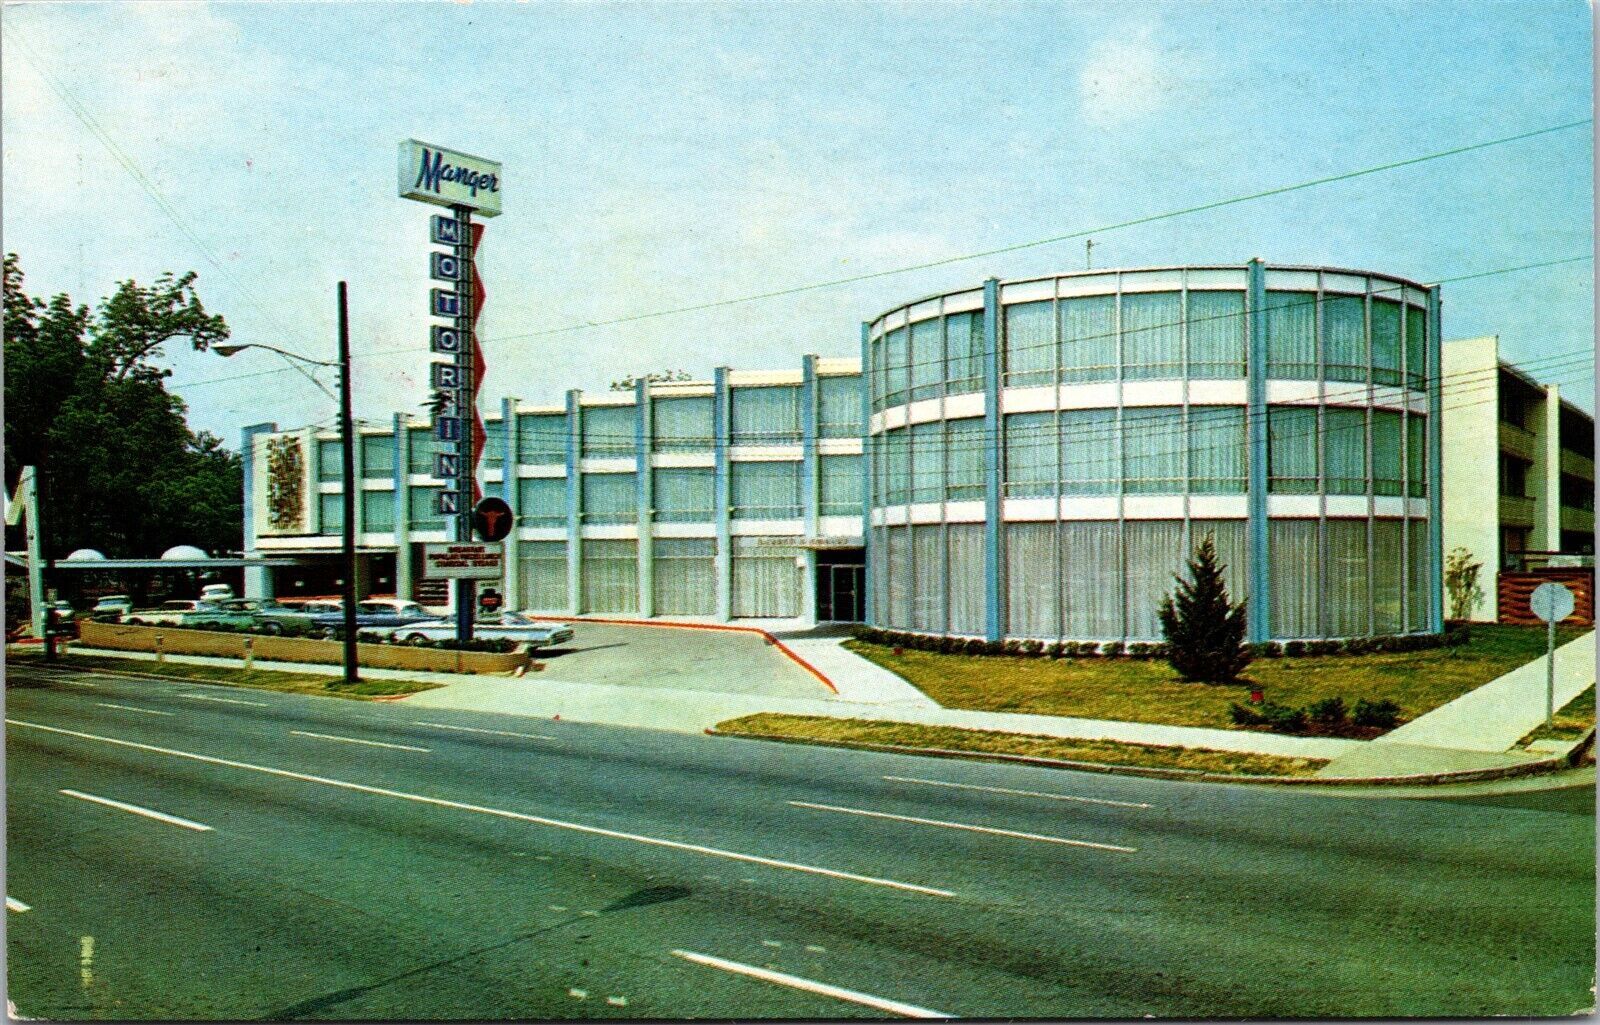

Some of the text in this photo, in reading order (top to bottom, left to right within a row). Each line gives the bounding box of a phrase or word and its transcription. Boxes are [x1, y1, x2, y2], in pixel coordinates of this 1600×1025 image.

[414, 147, 499, 197] Manger
[439, 218, 458, 515] MOTOR INN
